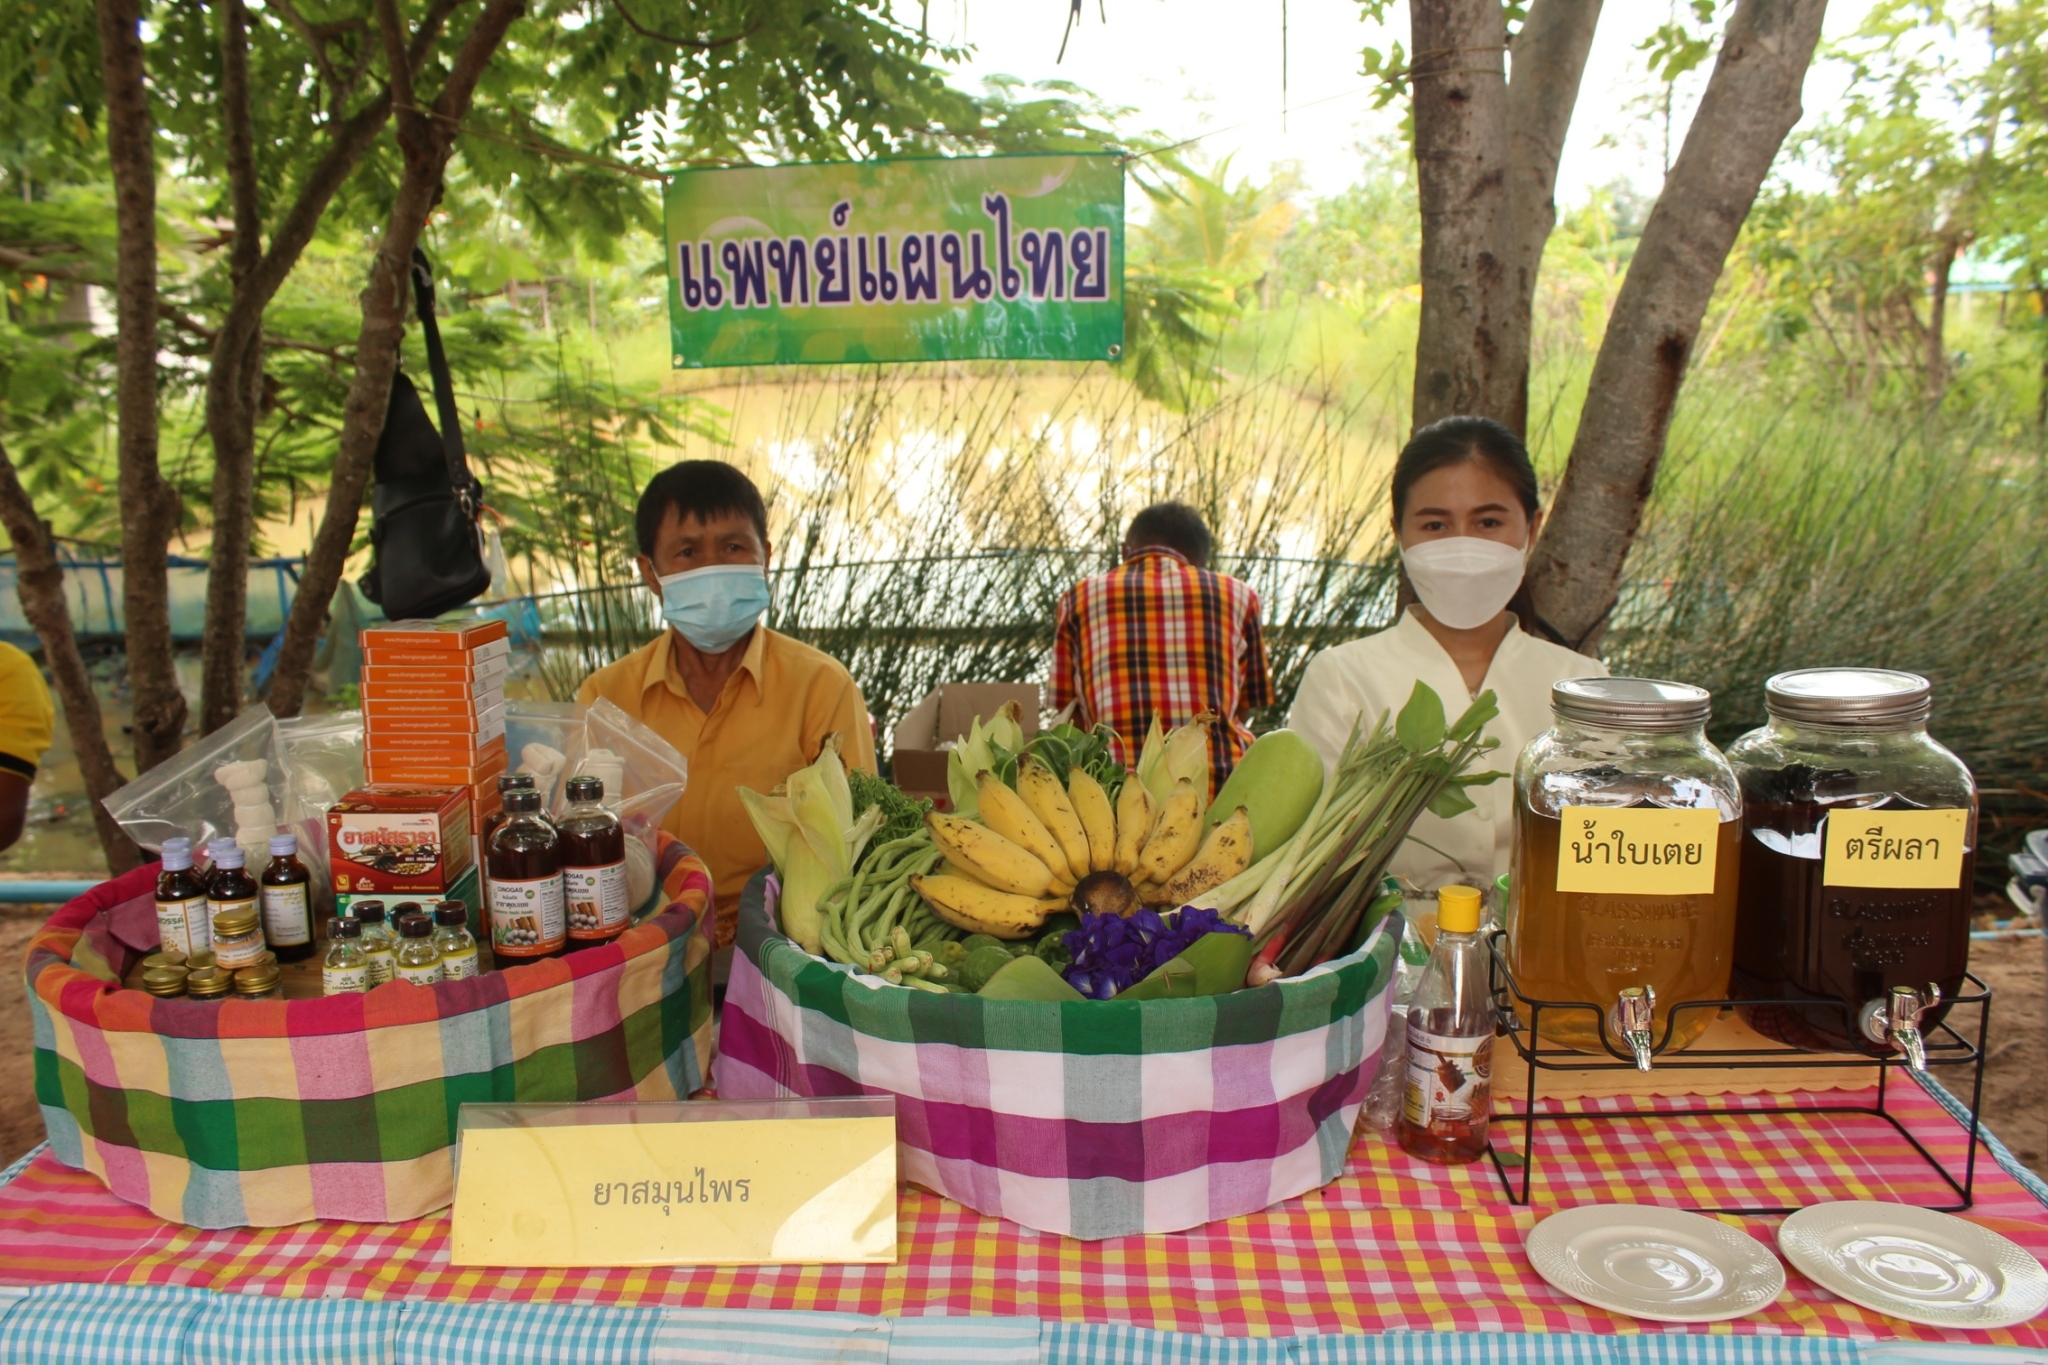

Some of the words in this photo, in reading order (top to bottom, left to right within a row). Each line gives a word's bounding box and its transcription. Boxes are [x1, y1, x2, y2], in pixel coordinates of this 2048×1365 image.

[678, 194, 1110, 310] แพทย์แผนไทย
[1570, 819, 1703, 866] น้ำใบเตย
[1845, 825, 1941, 862] ตรีผลา
[593, 1166, 752, 1217] ยาสมุนไพร
